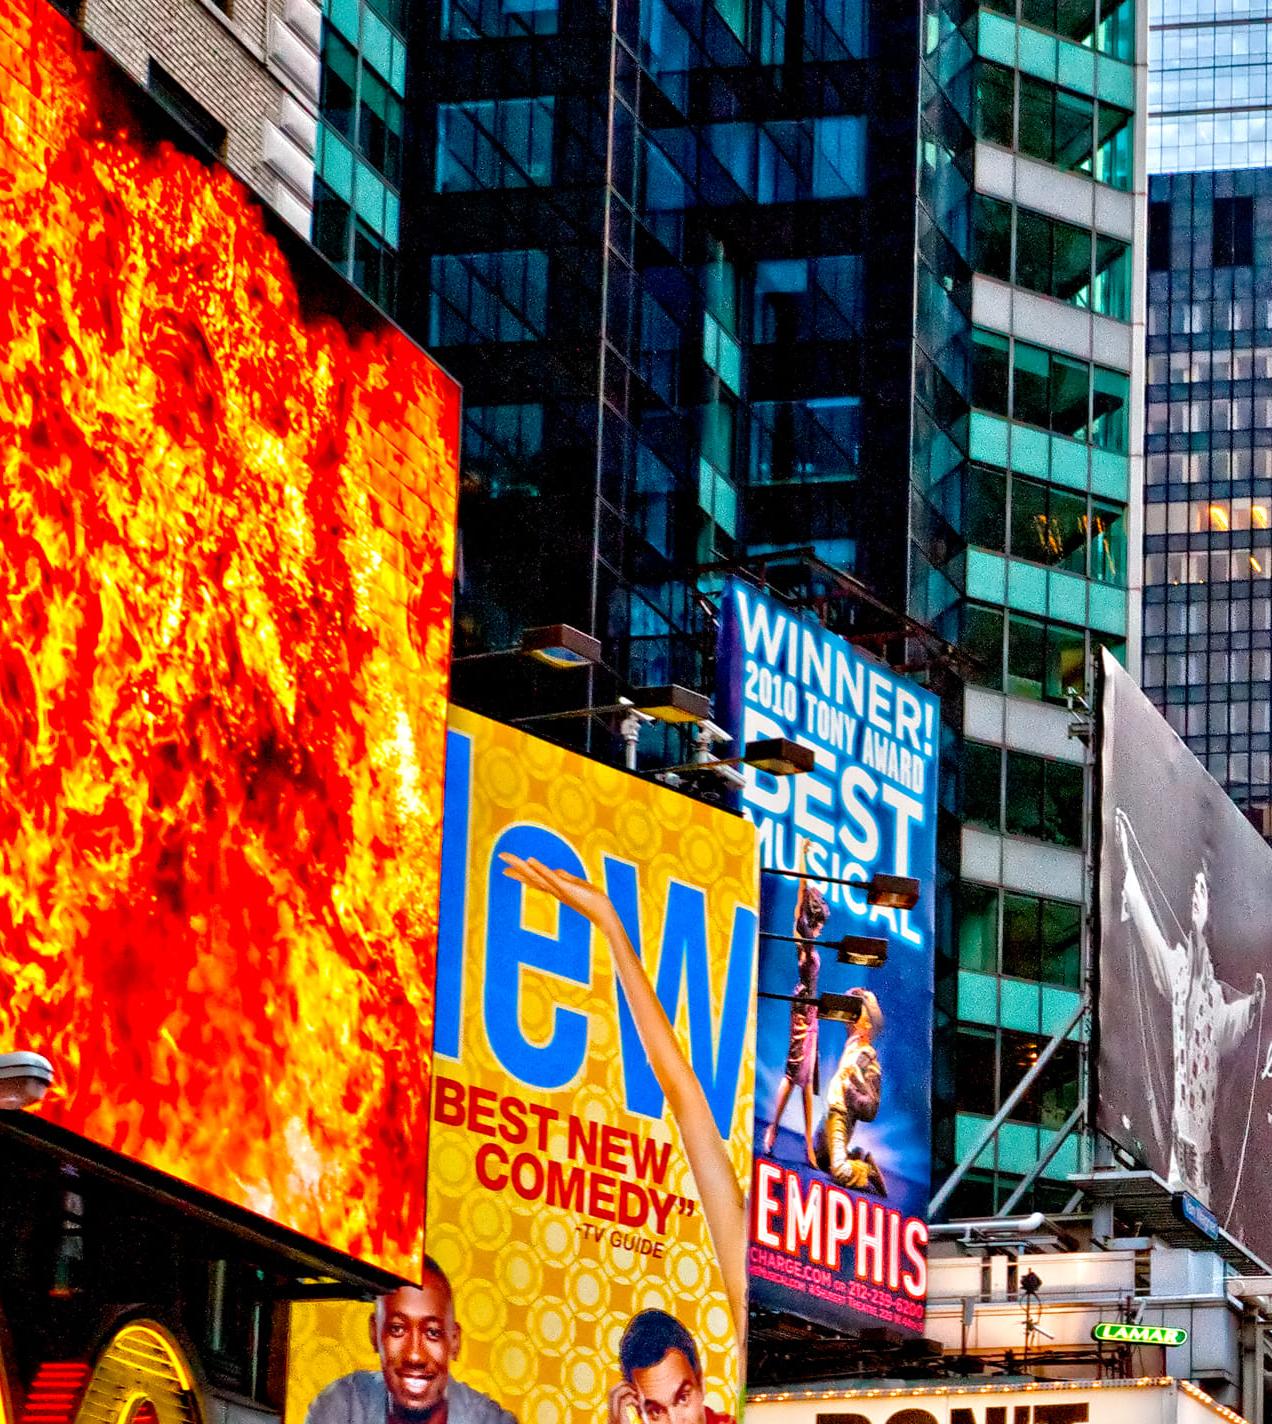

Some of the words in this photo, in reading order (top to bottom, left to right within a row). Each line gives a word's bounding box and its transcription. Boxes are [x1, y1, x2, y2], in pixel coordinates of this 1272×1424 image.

[736, 589, 937, 756] WINNER!
[745, 660, 798, 725] 2010
[804, 690, 857, 756] TONY
[859, 717, 926, 795] AWARD
[742, 714, 926, 881] BEST
[742, 811, 923, 946] MUSICAL
[434, 1077, 560, 1161] BEST
[566, 1117, 671, 1185] NEW
[608, 1230, 666, 1259] GUIDE
[848, 1280, 923, 1319] 212-239-6200
[1098, 1324, 1182, 1345] LAMAR
